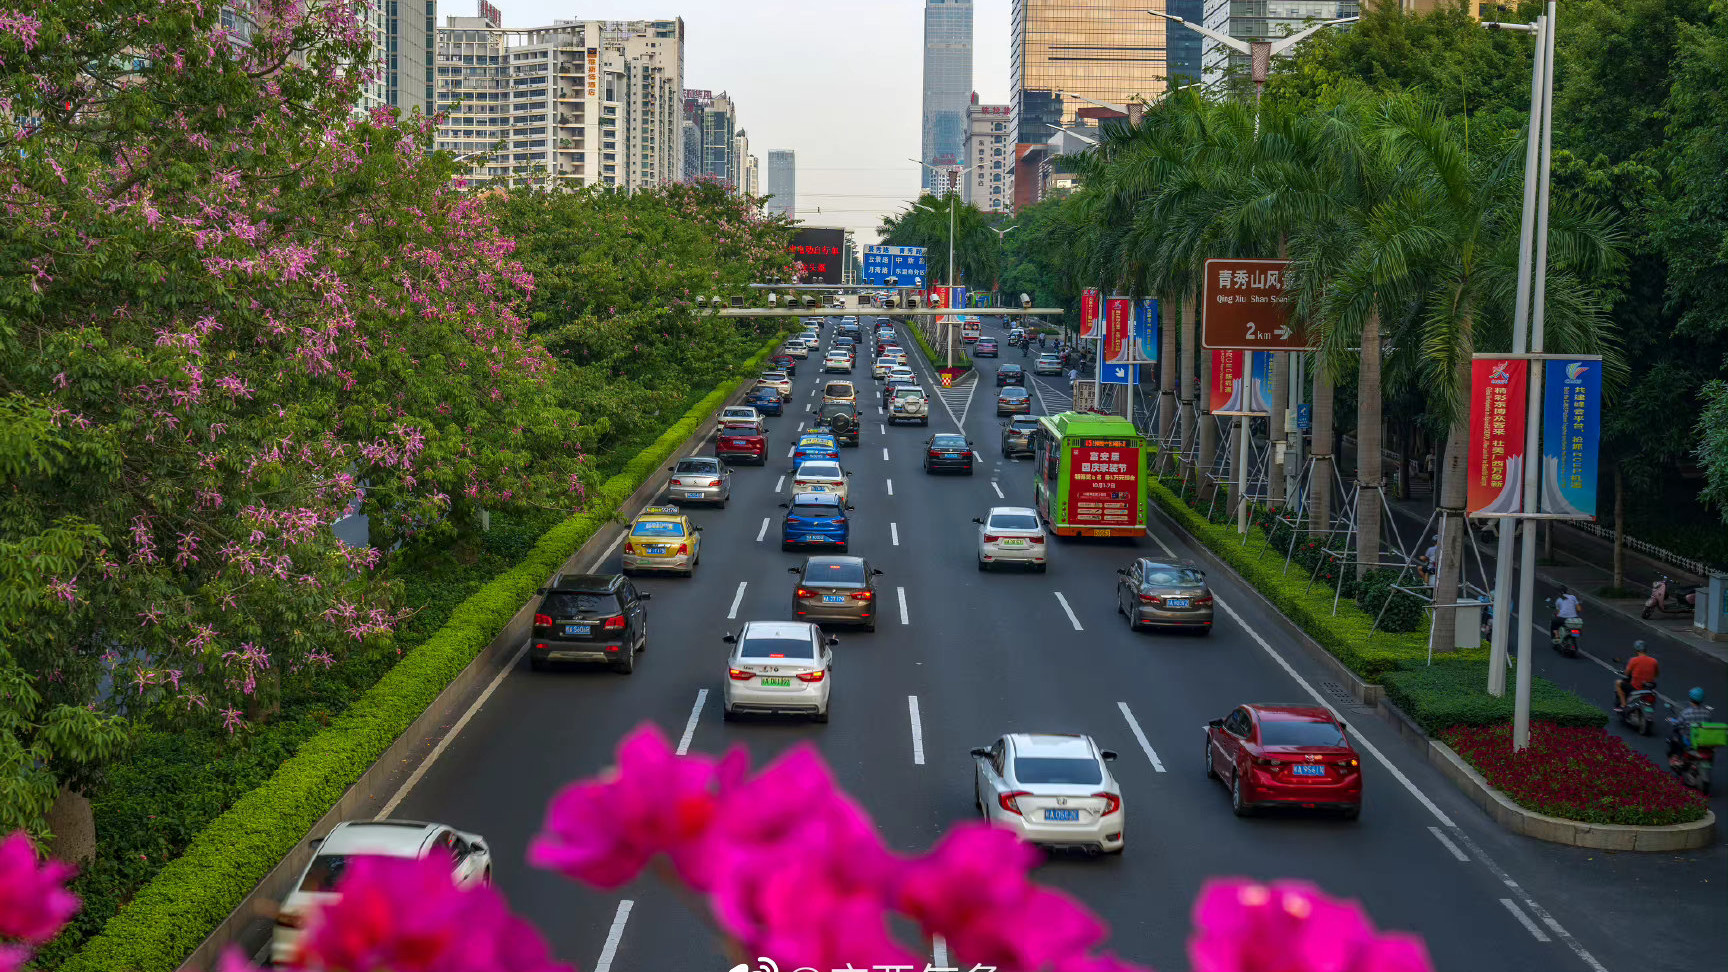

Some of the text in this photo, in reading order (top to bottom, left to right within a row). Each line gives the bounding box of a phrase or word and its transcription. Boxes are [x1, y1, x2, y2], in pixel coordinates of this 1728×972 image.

[1216, 295, 1233, 304] Qing
[1235, 295, 1247, 303] Xiu
[1250, 295, 1269, 303] Shan
[1245, 321, 1271, 340] 2 km
[1081, 463, 1127, 472] 国庆家装节
